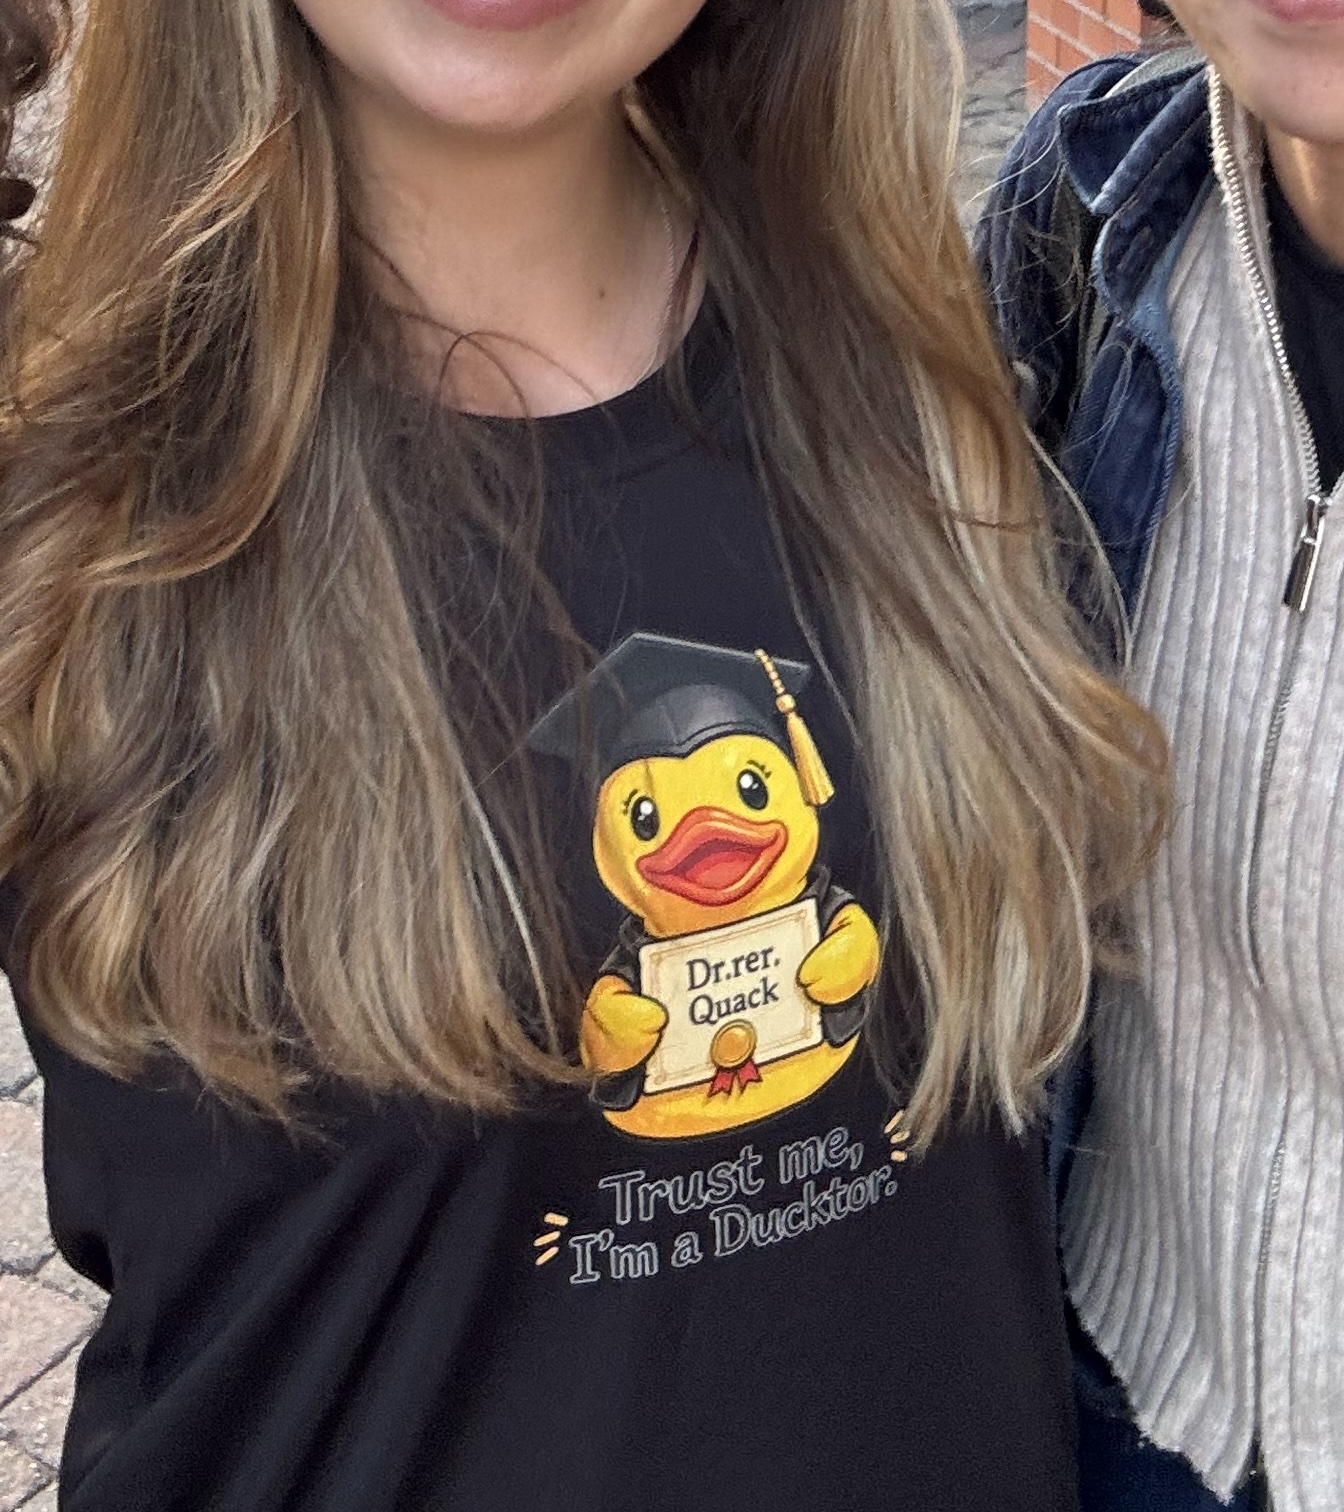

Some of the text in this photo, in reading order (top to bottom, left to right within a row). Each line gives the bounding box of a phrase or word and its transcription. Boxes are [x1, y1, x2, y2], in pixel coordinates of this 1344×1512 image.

[689, 976, 780, 1026] Quack
[568, 1164, 898, 1285] I'm a Ducktor.
[598, 1126, 864, 1226] Trust me,
